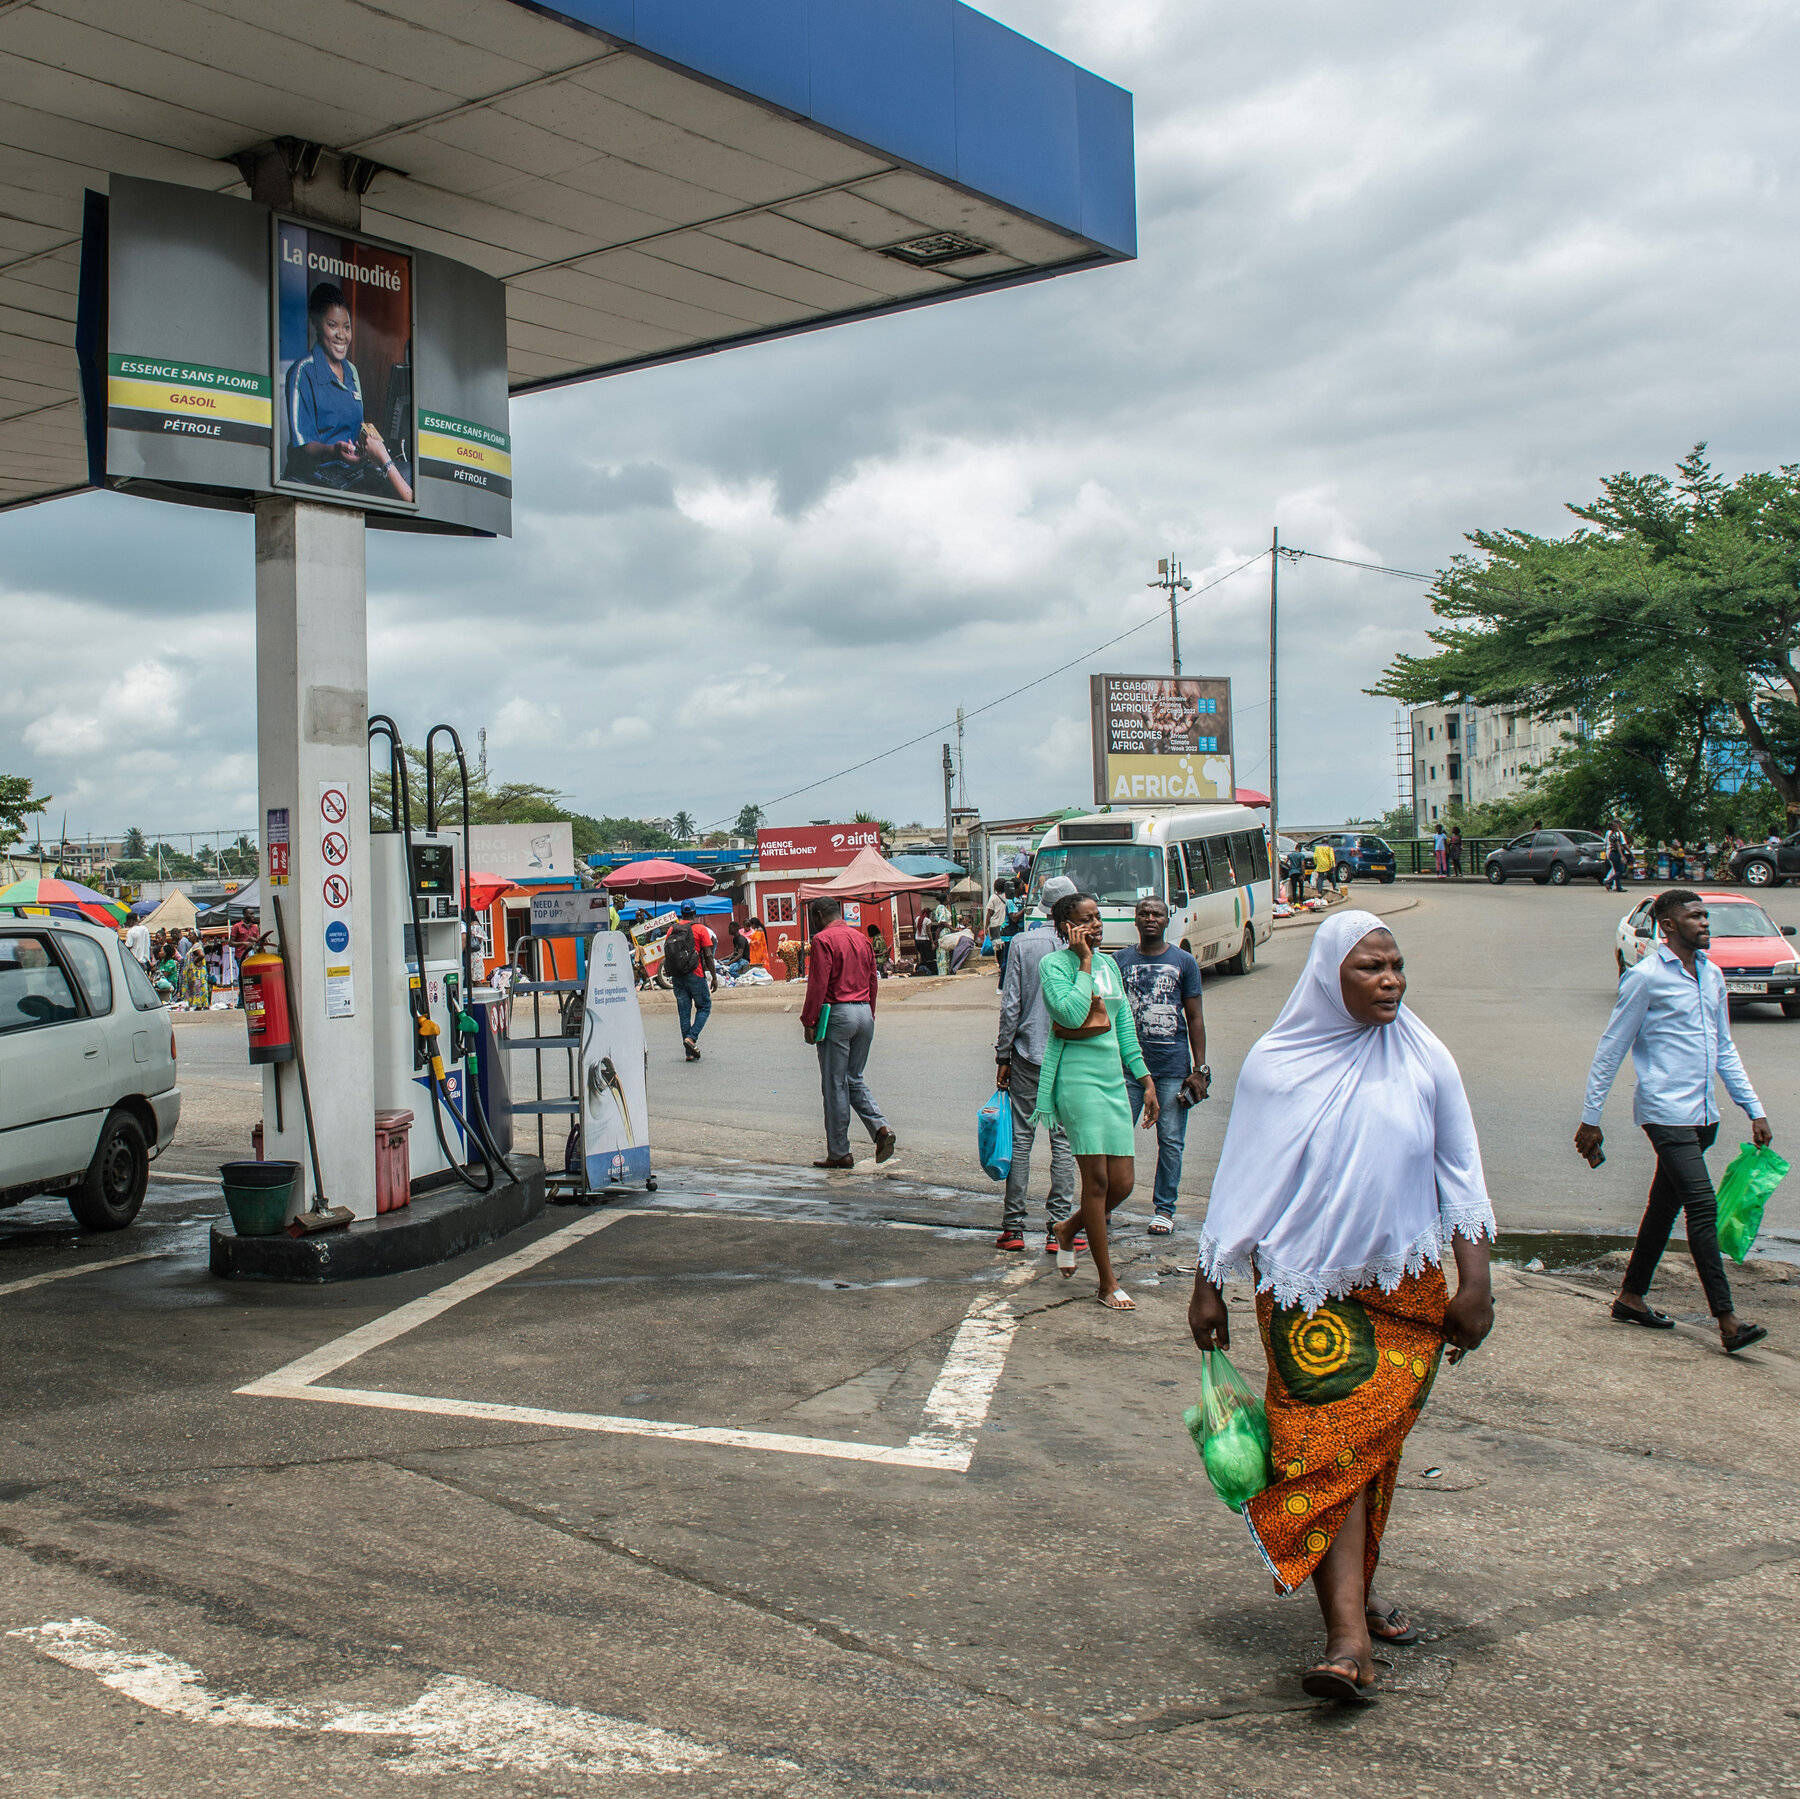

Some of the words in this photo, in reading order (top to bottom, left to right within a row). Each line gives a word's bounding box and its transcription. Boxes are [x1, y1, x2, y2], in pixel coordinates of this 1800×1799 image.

[283, 238, 303, 266] La
[308, 252, 400, 292] commodité
[120, 361, 179, 378] ESSENCE
[181, 369, 214, 383] SANS
[216, 374, 259, 390] PLOMB
[170, 394, 216, 408] GASOIL
[164, 419, 222, 436] PÉTROLE
[424, 416, 462, 432] ESSENCE
[463, 425, 482, 438] SANS
[483, 431, 505, 446] PLOMB
[456, 446, 484, 461] GASOIL
[454, 469, 488, 486] PÉTROLE
[1110, 680, 1120, 690] LE
[1122, 681, 1153, 690] GABON
[1110, 692, 1158, 702] ACCUEILLE
[1110, 702, 1152, 713] L'AFRIQUE
[1111, 719, 1143, 728] GABON
[1111, 730, 1162, 740] WELCOMES
[1112, 740, 1144, 750] AFRICA
[1114, 774, 1200, 798] AFRICA
[760, 840, 793, 849] AGENCE
[847, 831, 878, 846] airtel
[760, 848, 788, 856] AIRTEL
[790, 846, 817, 855] MONEY
[534, 900, 552, 909] NEED
[553, 899, 560, 908] A
